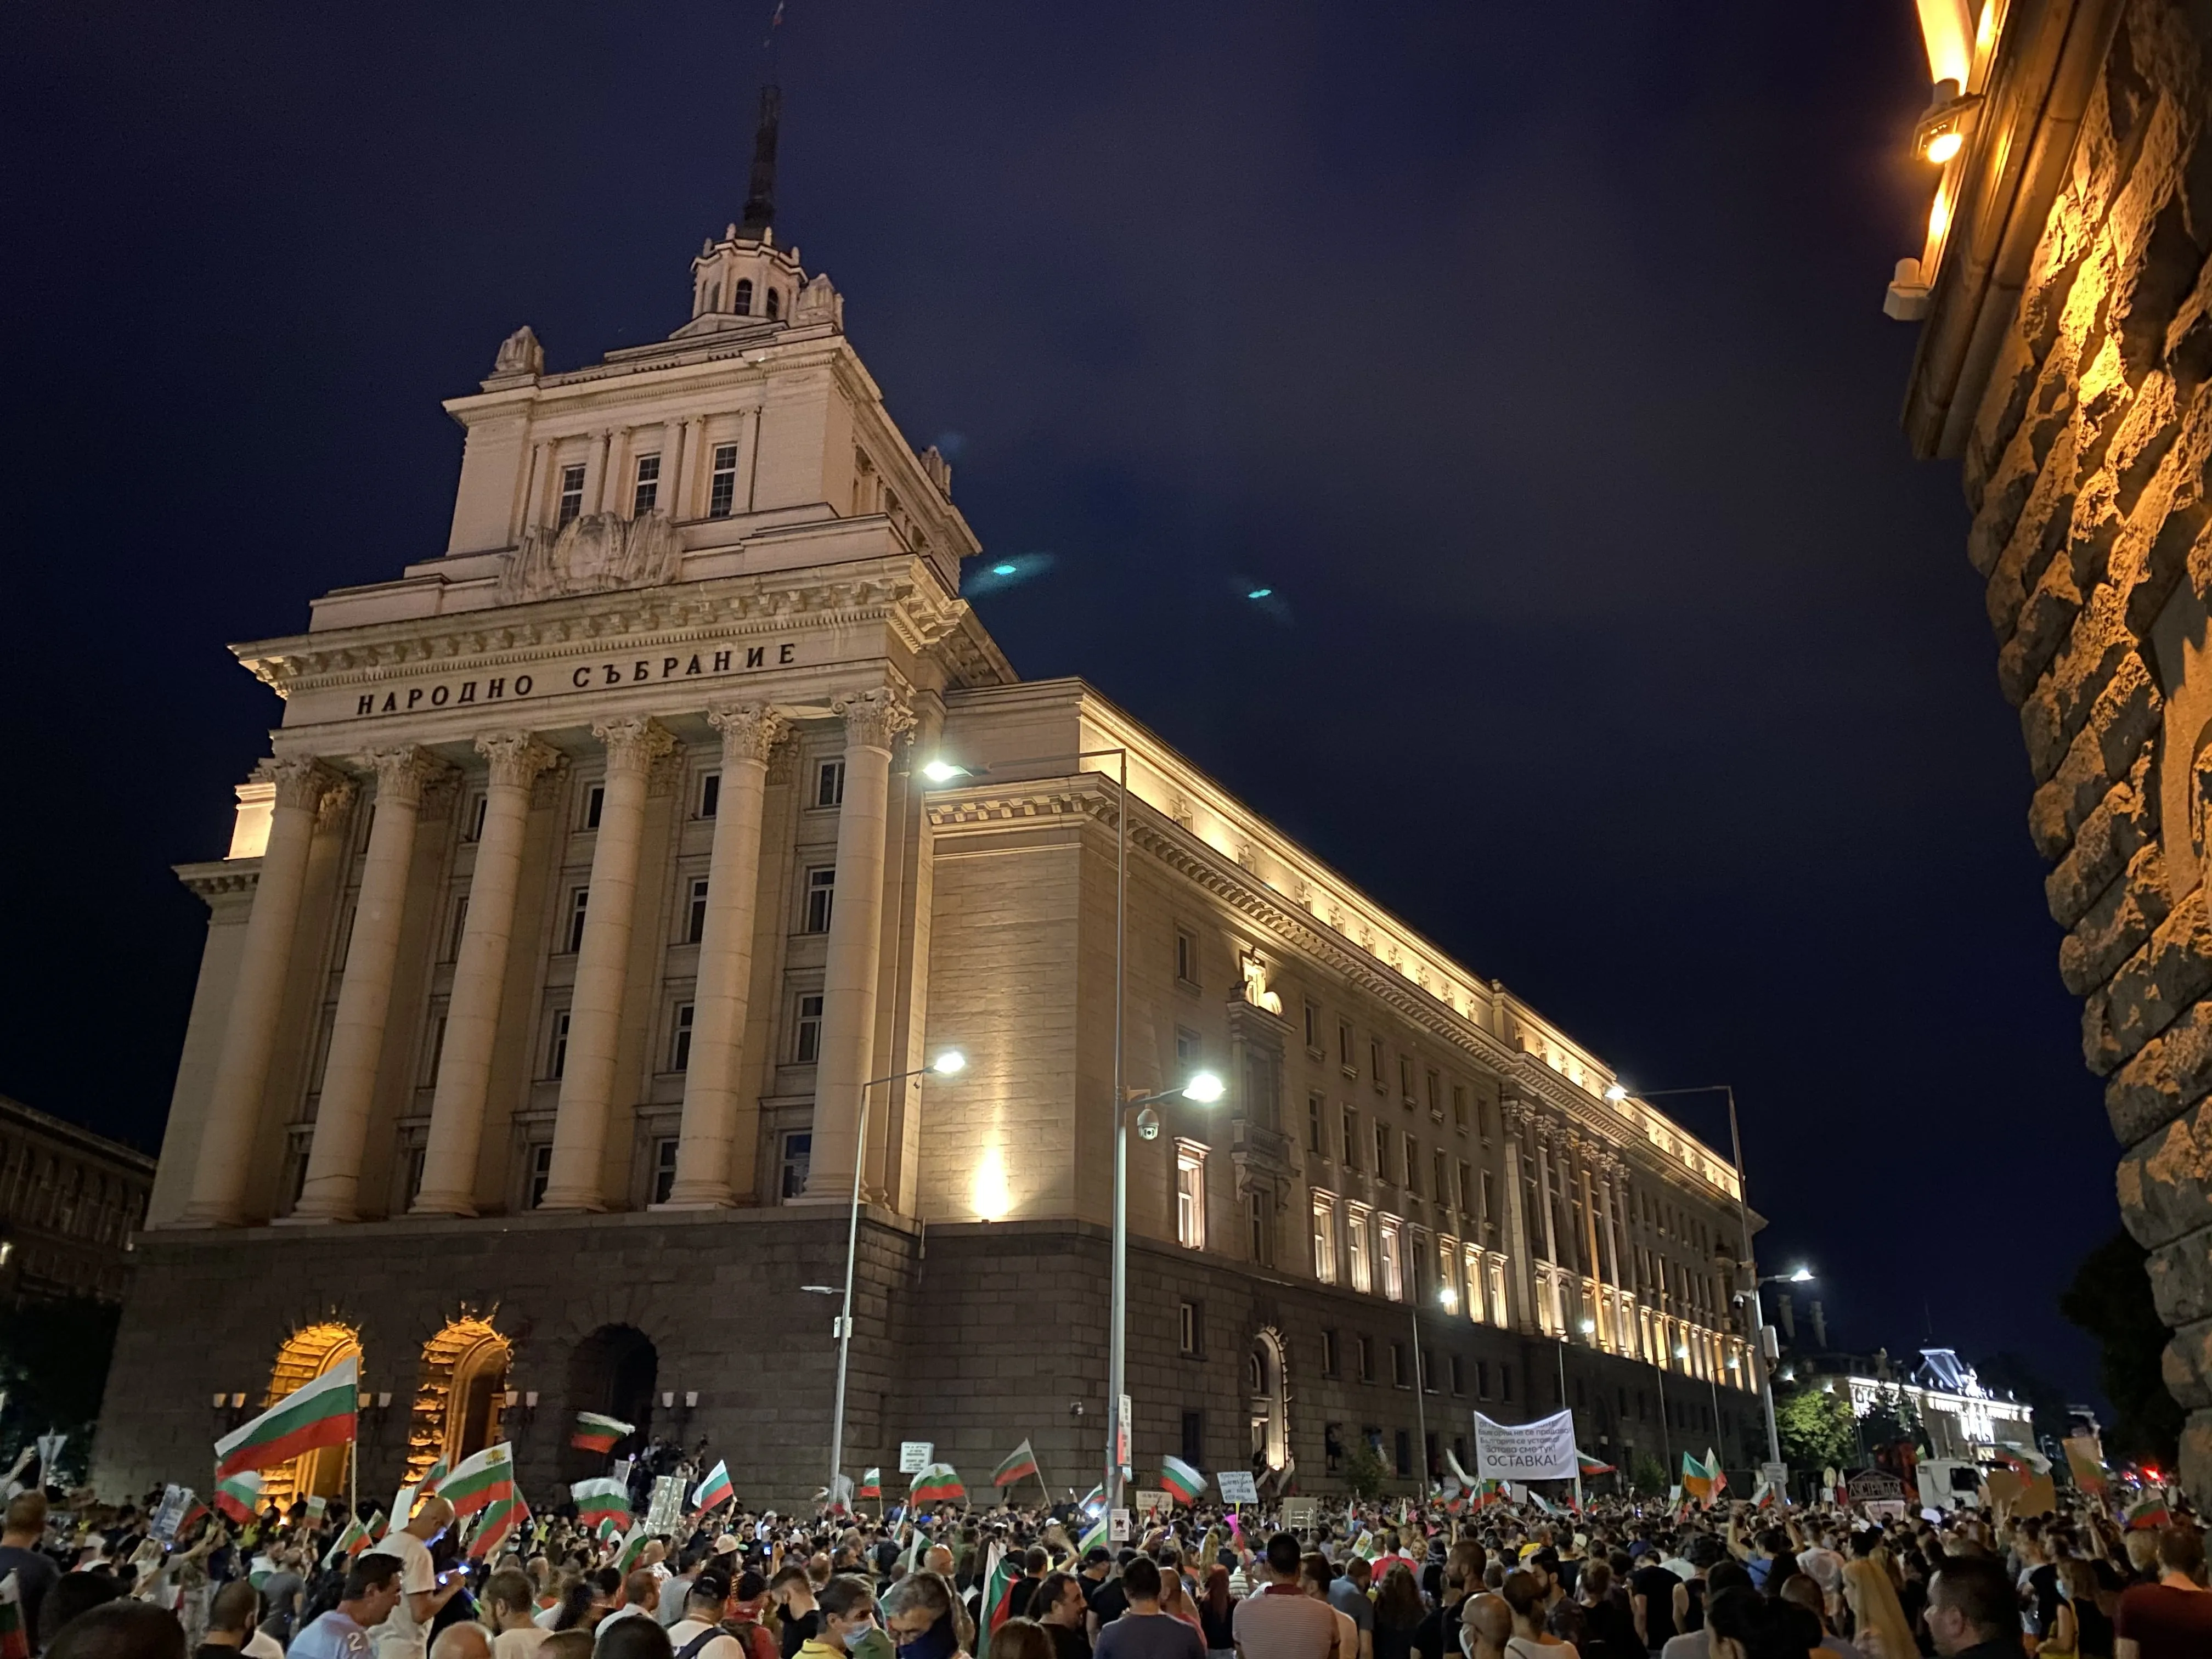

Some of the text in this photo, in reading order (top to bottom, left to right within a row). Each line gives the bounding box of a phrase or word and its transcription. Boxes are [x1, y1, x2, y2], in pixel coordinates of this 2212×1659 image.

[357, 643, 796, 715] НАРОДНО СЪБРАНИЕ
[1486, 1444, 1517, 1453] Затова
[1487, 1454, 1557, 1467] ОСТАВКА!
[347, 1632, 363, 1652] 2
